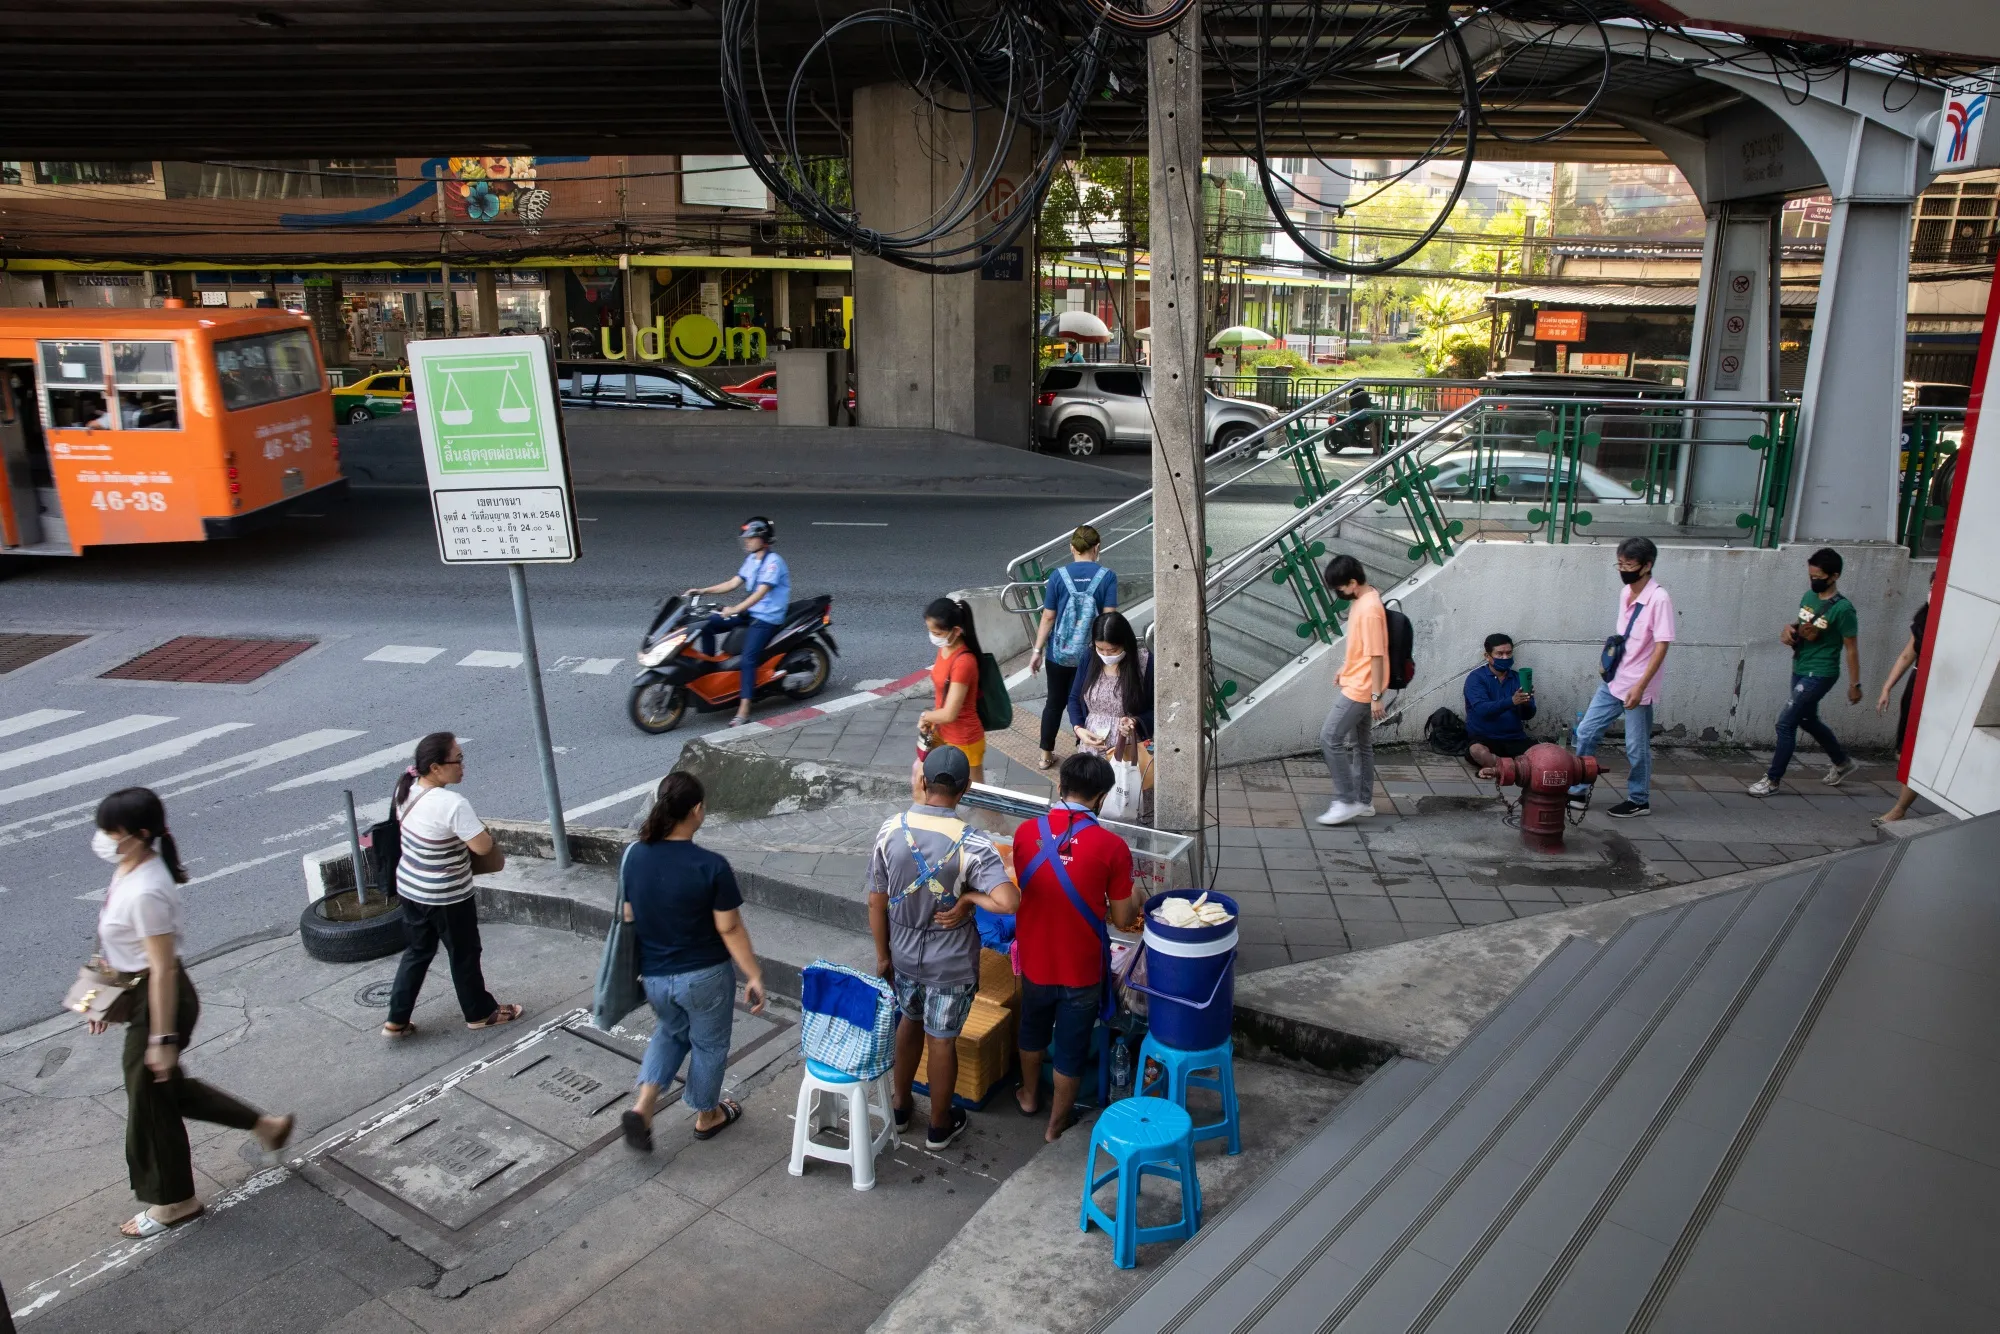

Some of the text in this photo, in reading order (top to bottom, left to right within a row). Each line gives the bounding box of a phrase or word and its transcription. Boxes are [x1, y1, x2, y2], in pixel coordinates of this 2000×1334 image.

[77, 276, 130, 287] LAWSON
[444, 440, 541, 466] สิ้นสุดจุดผ่อนผัน
[91, 491, 168, 511] 46-38
[477, 497, 522, 507] เขตบางนา
[443, 510, 459, 523] จุดที่
[470, 509, 511, 522] วันที่อนุญาต
[512, 511, 521, 520] 31
[540, 510, 561, 519] 2548
[454, 537, 471, 545] เวลา
